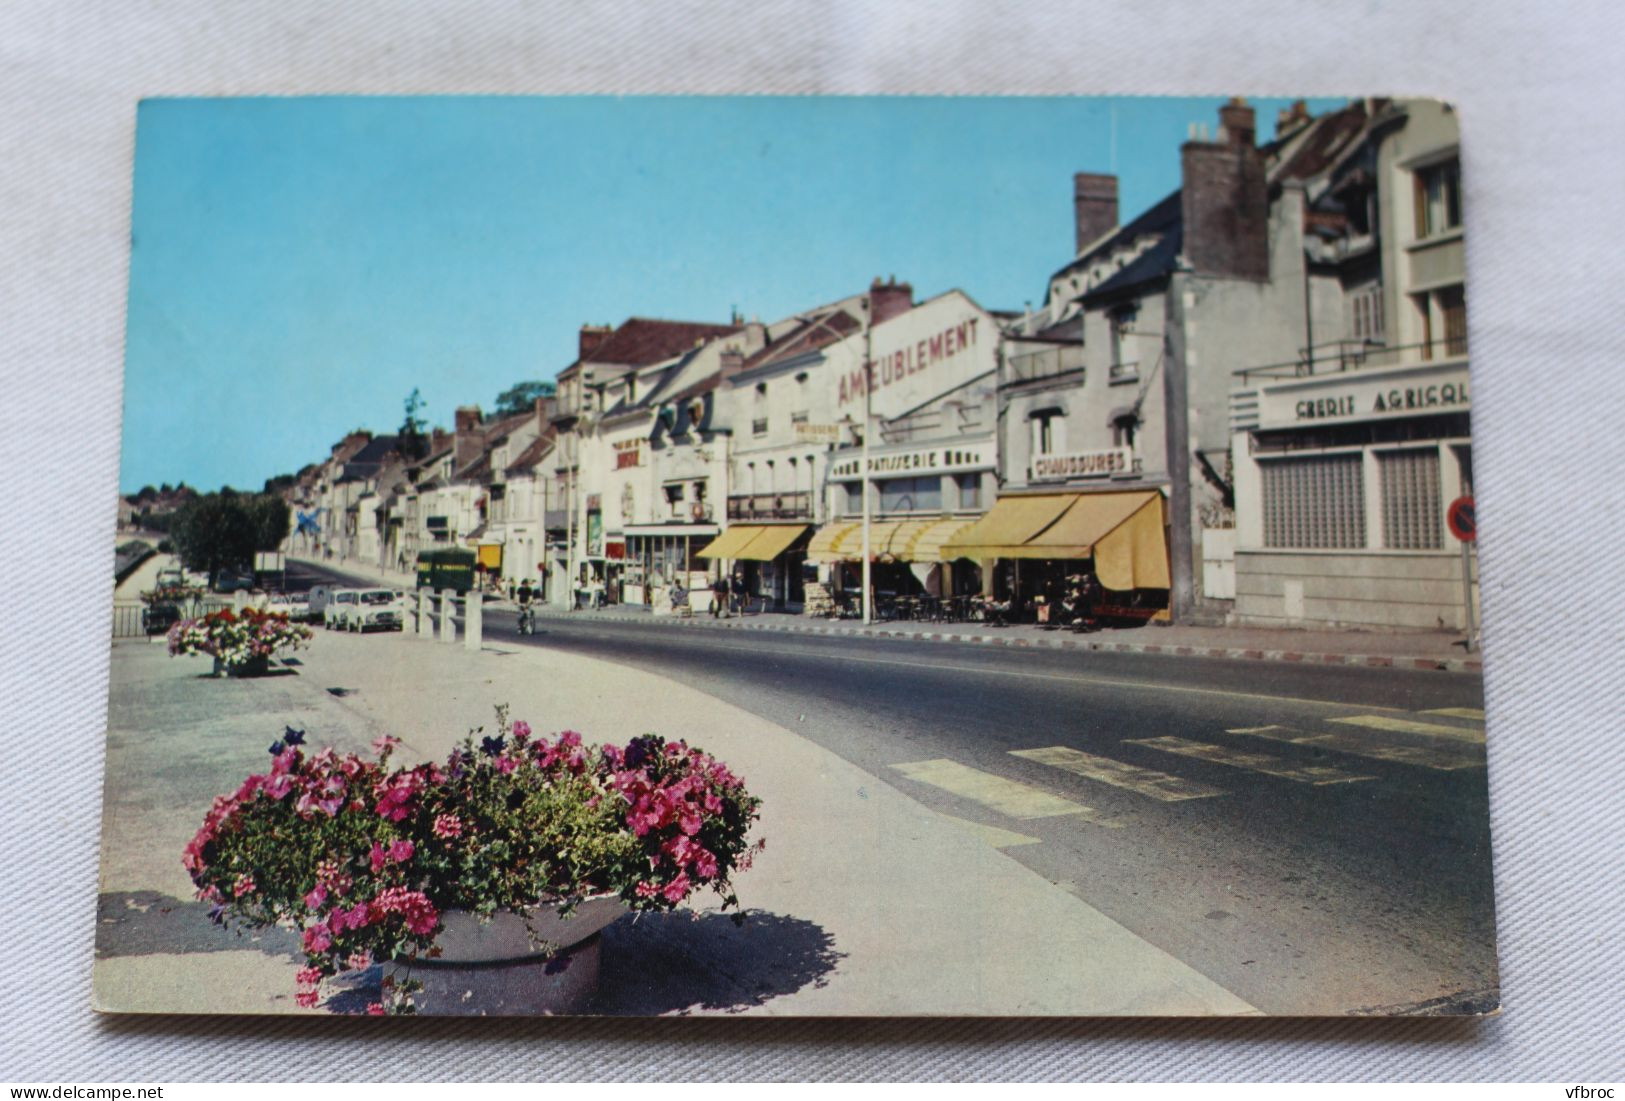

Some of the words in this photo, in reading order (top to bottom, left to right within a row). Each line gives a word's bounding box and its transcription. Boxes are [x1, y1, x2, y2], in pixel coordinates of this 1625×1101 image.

[838, 318, 978, 408] AMEUBLEMENT
[1295, 395, 1355, 421] CREDIT
[868, 452, 937, 472] PATISSERIE
[1035, 451, 1125, 476] CHAUSSURES
